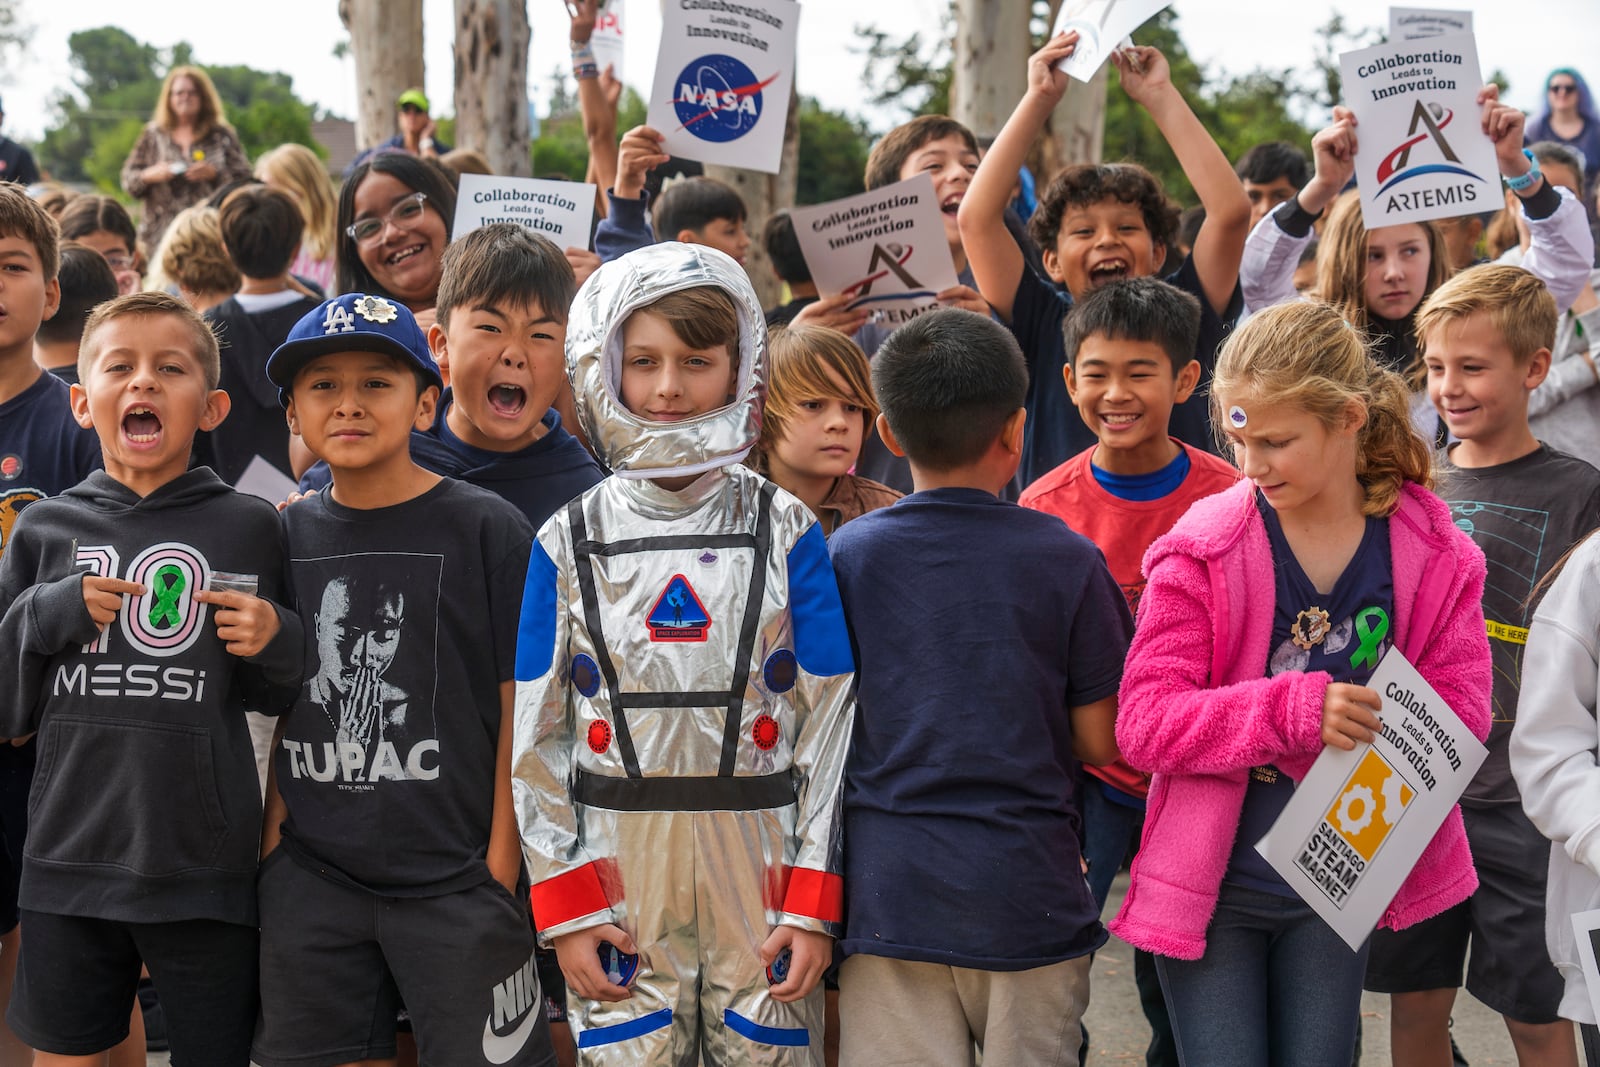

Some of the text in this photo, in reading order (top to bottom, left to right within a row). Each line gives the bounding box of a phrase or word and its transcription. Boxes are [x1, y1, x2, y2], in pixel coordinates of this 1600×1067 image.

[686, 25, 769, 52] Innovation
[1358, 50, 1462, 78] Collaboration
[1391, 67, 1433, 80] Leads to
[679, 82, 758, 116] NASA
[1371, 77, 1456, 101] Innovation
[473, 189, 577, 212] Collaboration
[503, 204, 545, 216] Leads to
[812, 194, 919, 233] Collaboration
[1386, 183, 1477, 214] ARTEMIS
[828, 218, 915, 250] Innovation
[879, 213, 890, 222] to
[322, 301, 355, 335] LA
[1508, 629, 1528, 641] HERE
[1385, 681, 1462, 773] Collaboration
[1401, 717, 1434, 756] Leads to
[281, 738, 440, 783] TUPAC
[1308, 833, 1359, 890] STEAM
[1318, 821, 1365, 873] SANTIAGO
[1298, 850, 1348, 902] MAGNET
[492, 947, 539, 1031] NIK
